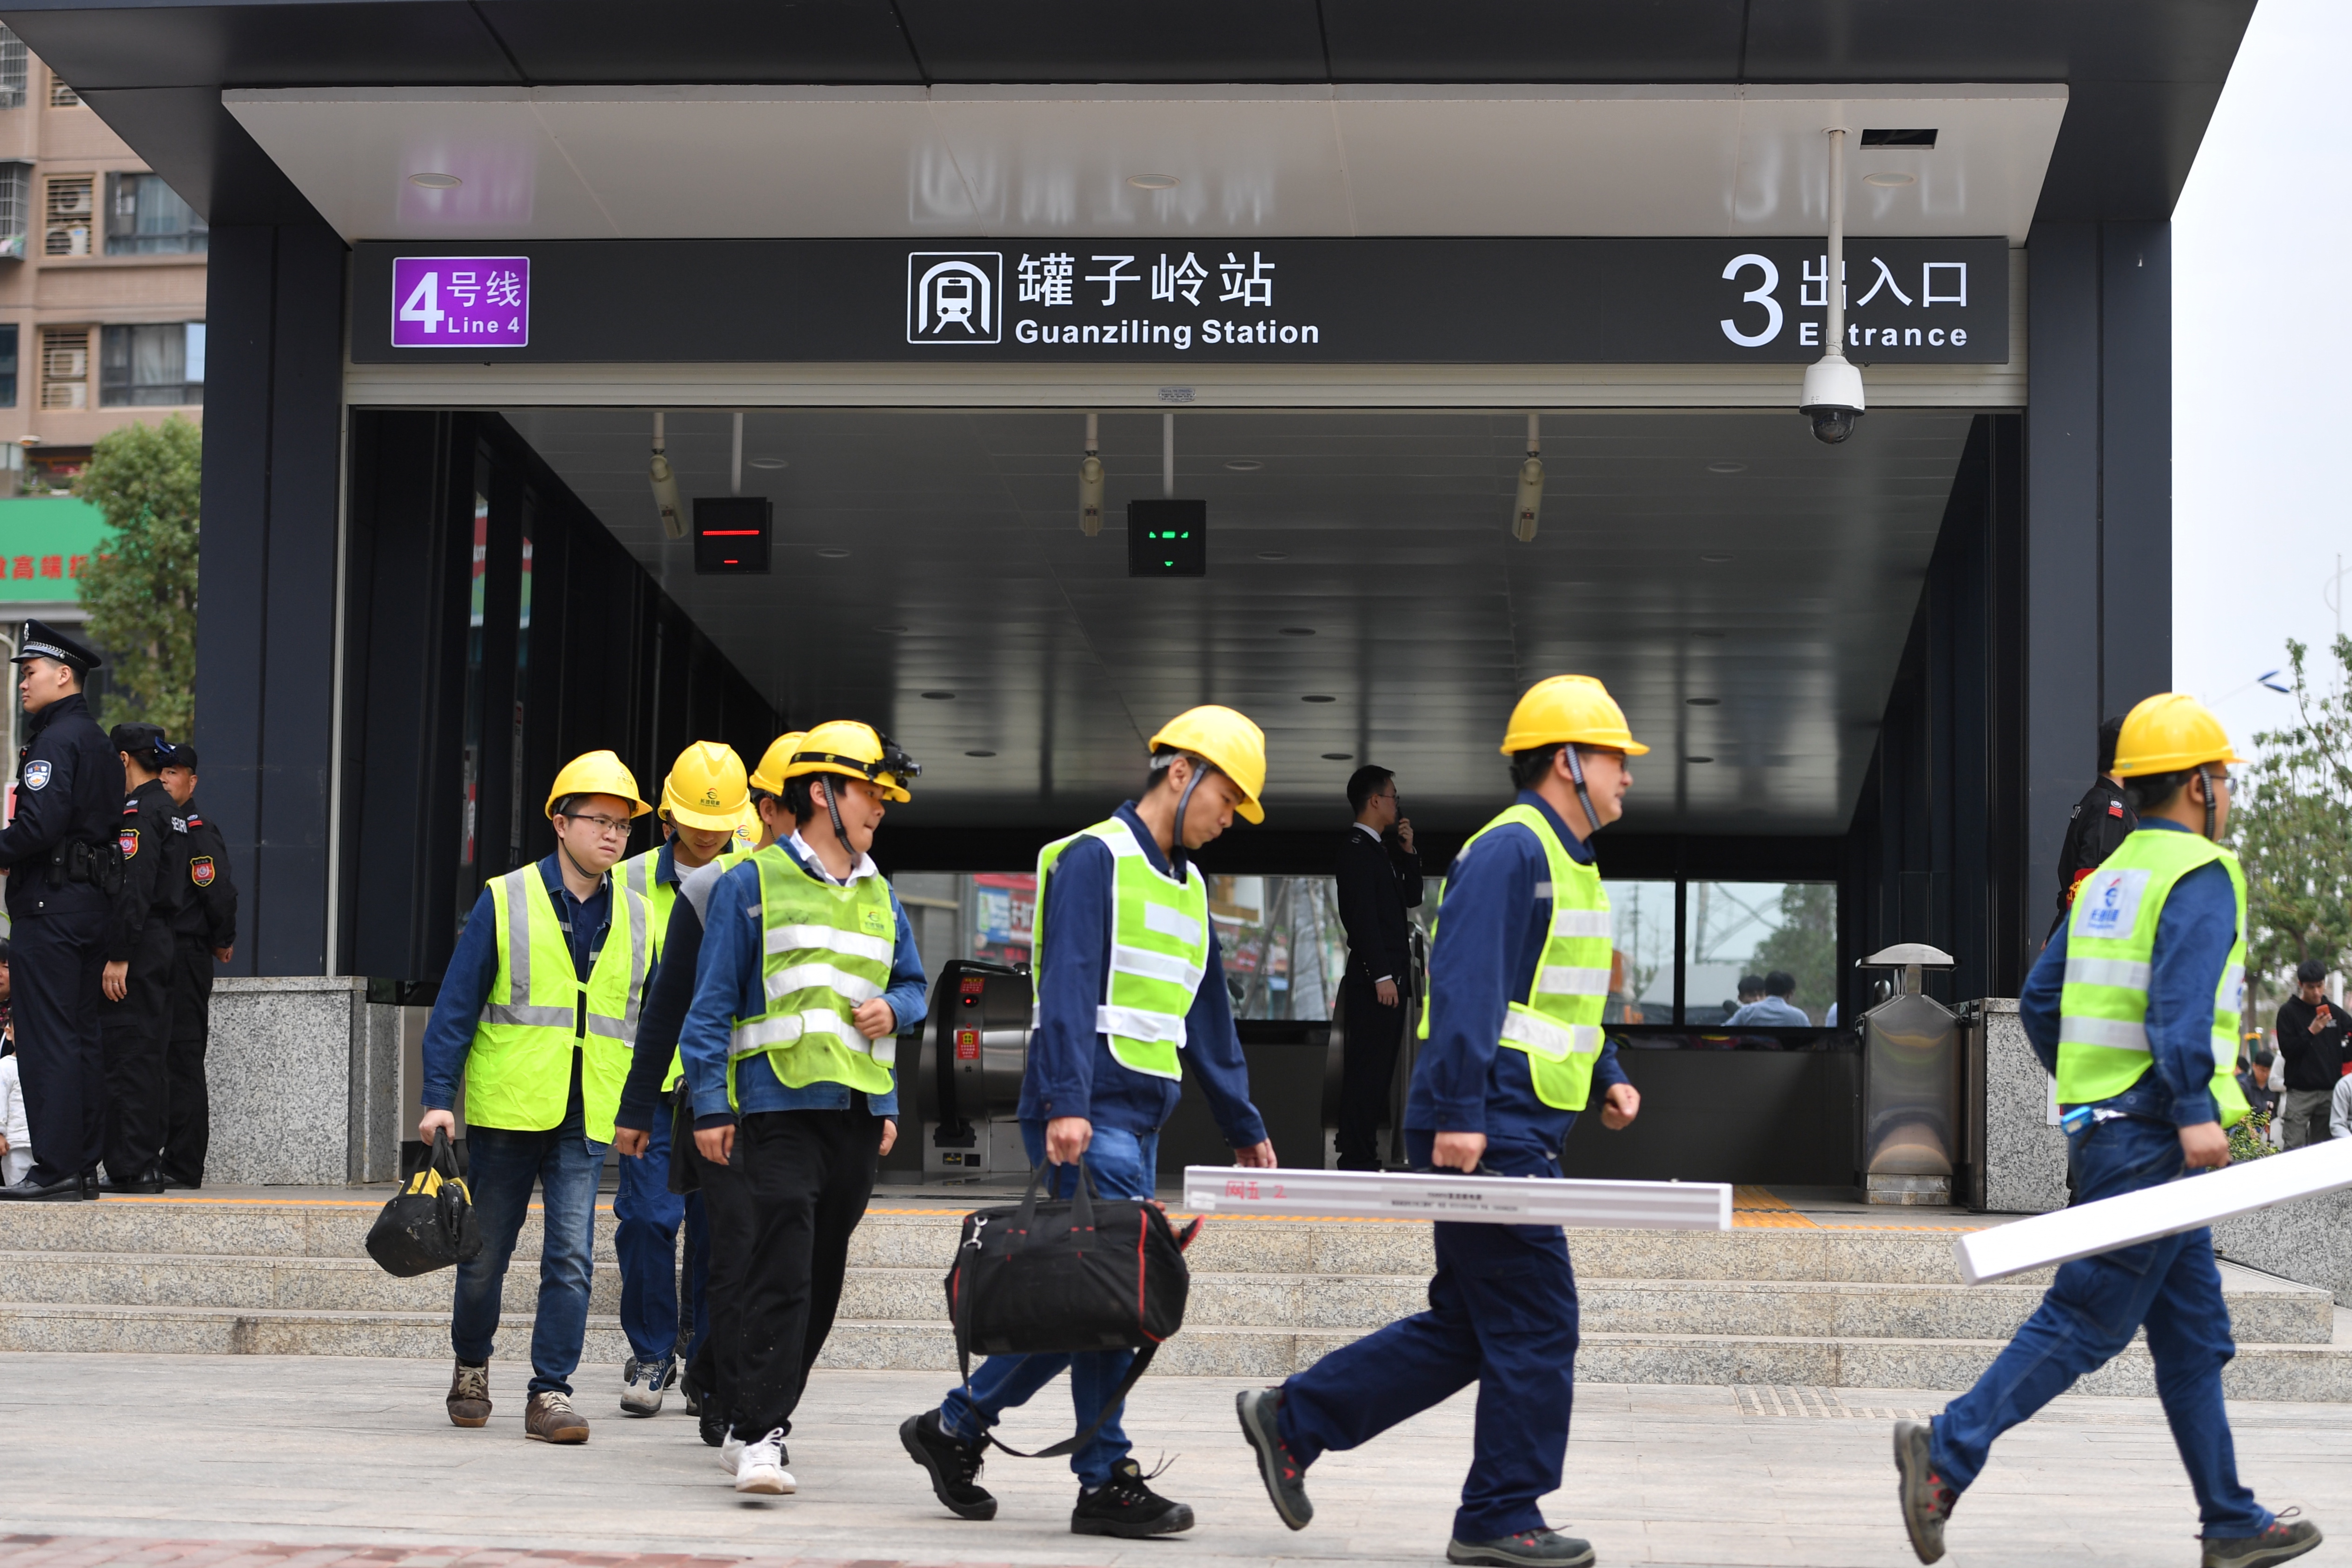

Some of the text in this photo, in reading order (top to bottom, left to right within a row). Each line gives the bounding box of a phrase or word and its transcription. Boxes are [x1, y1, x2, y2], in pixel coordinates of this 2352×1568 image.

[1017, 251, 1276, 307] 罐子岭站
[1721, 253, 1967, 347] 3 出入口
[448, 317, 520, 333] Line 4
[1016, 319, 1319, 350] Guanziling Station
[1800, 322, 1967, 346] Etrance
